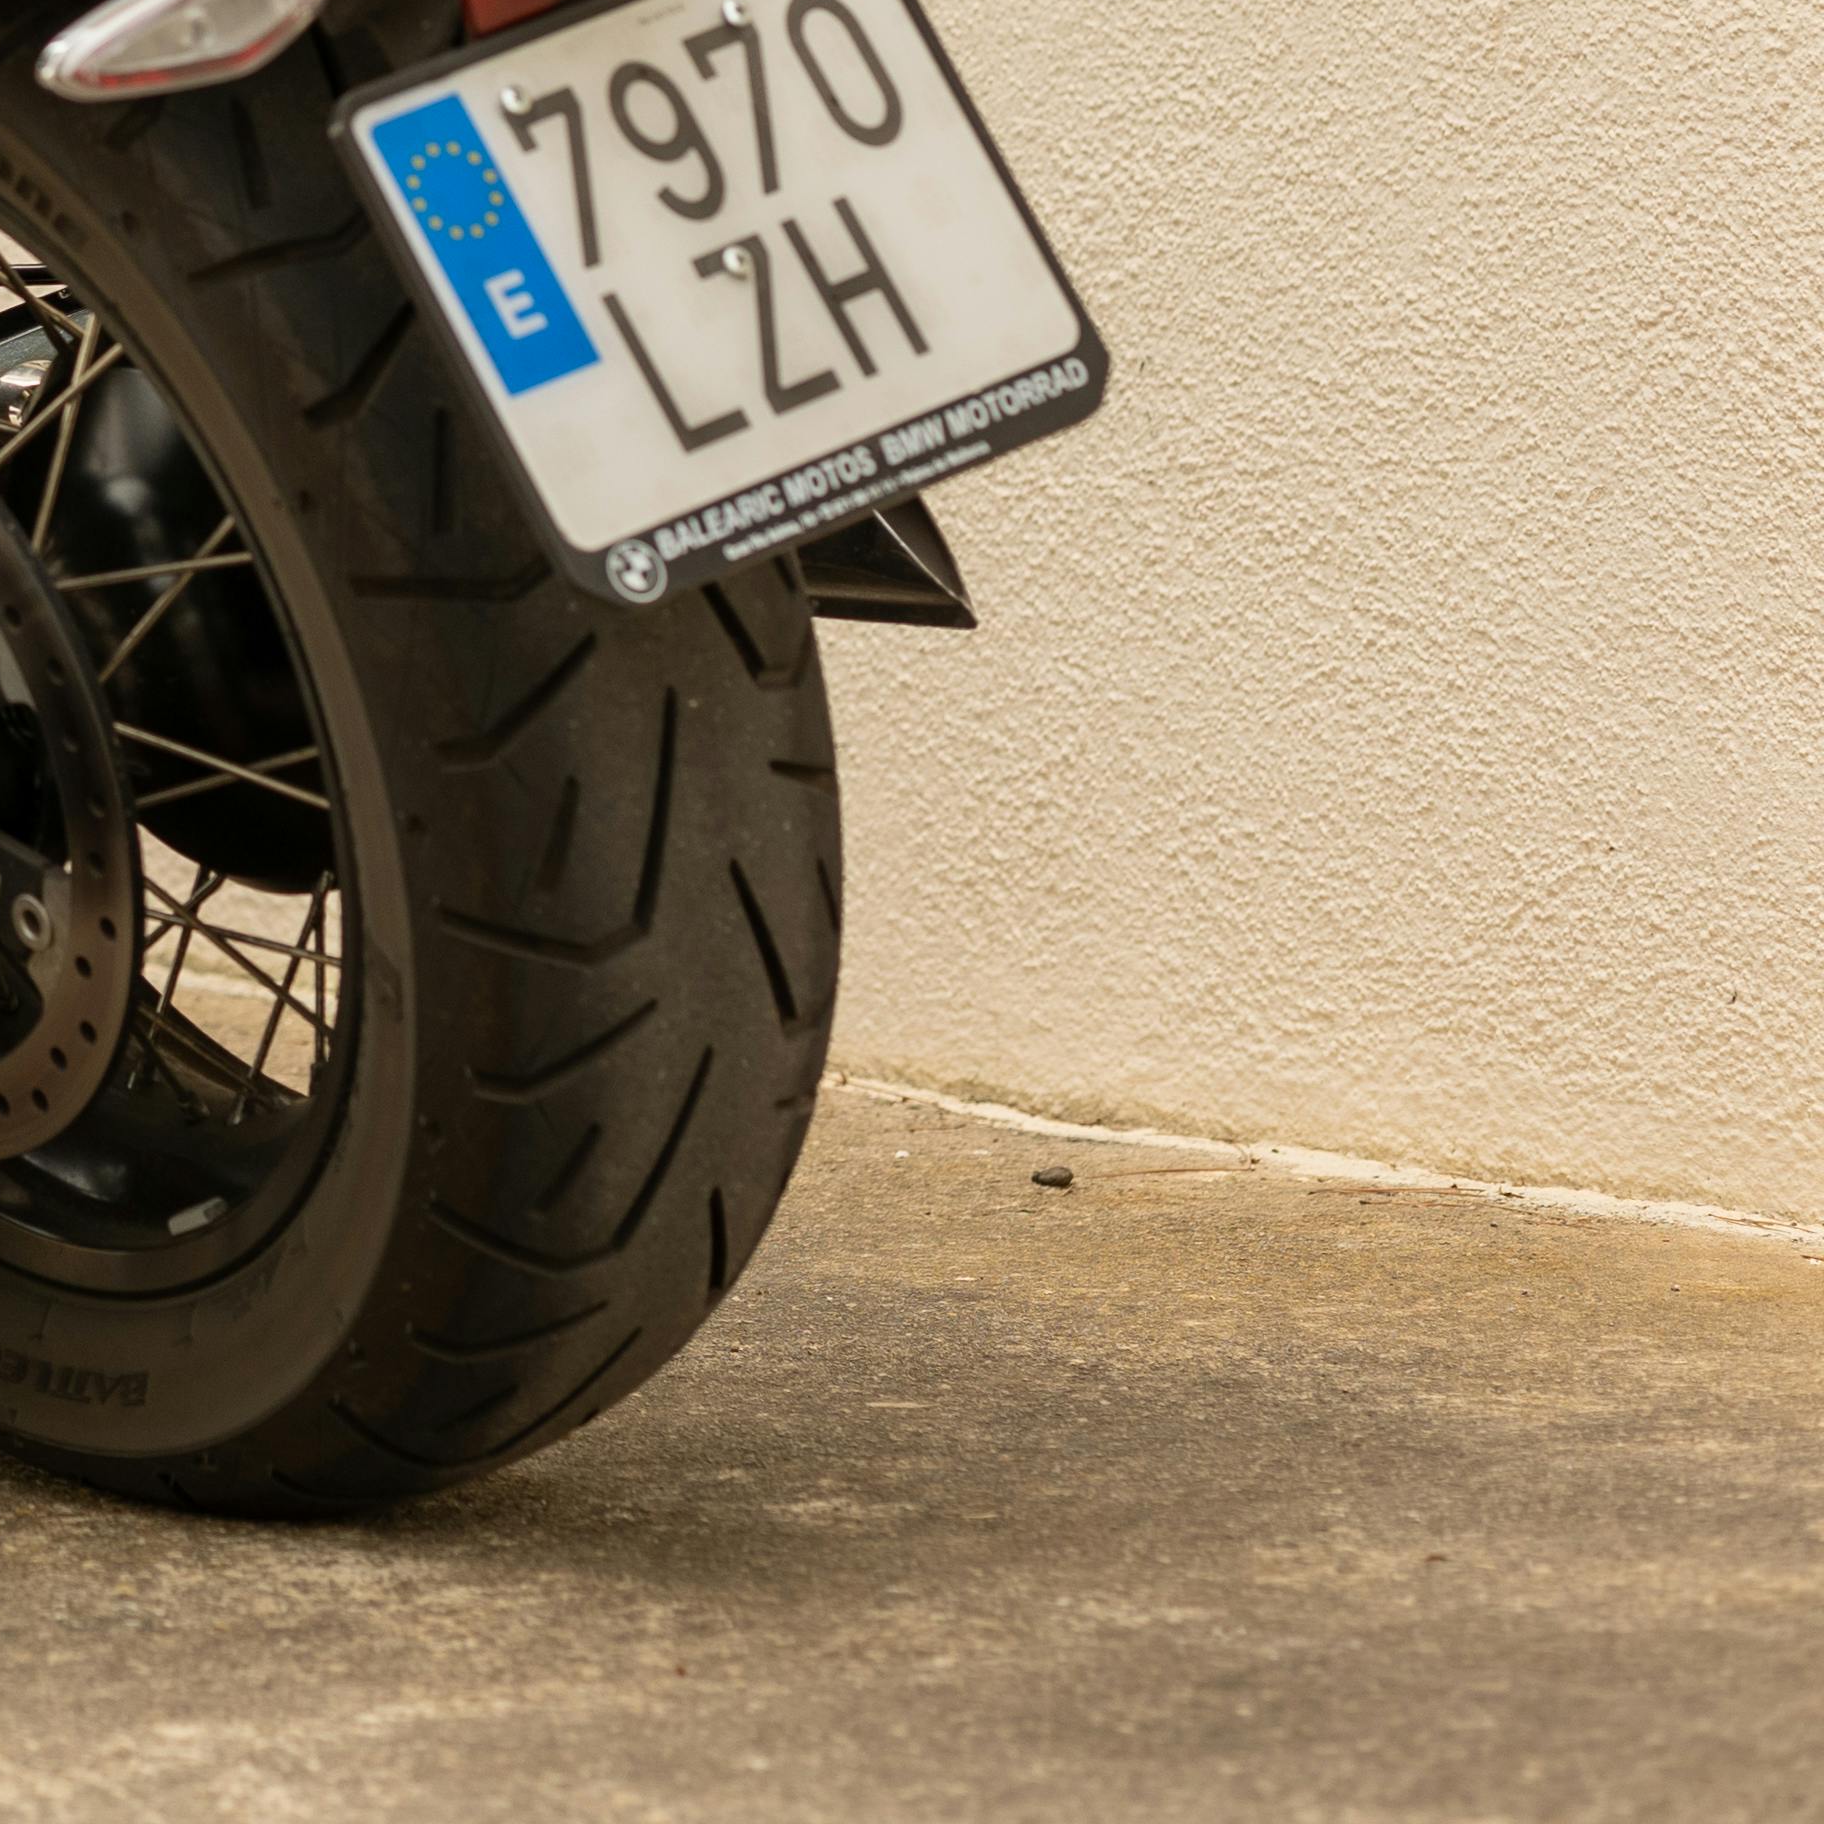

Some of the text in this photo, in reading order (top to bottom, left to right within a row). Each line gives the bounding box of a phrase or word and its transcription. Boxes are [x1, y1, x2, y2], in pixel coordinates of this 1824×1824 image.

[484, 269, 548, 340] E
[601, 197, 931, 453] LZH
[653, 483, 786, 562] BALEARIC
[782, 445, 877, 508] MOTOS
[879, 414, 947, 466] BMW
[944, 357, 1090, 439] MOTORRAD
